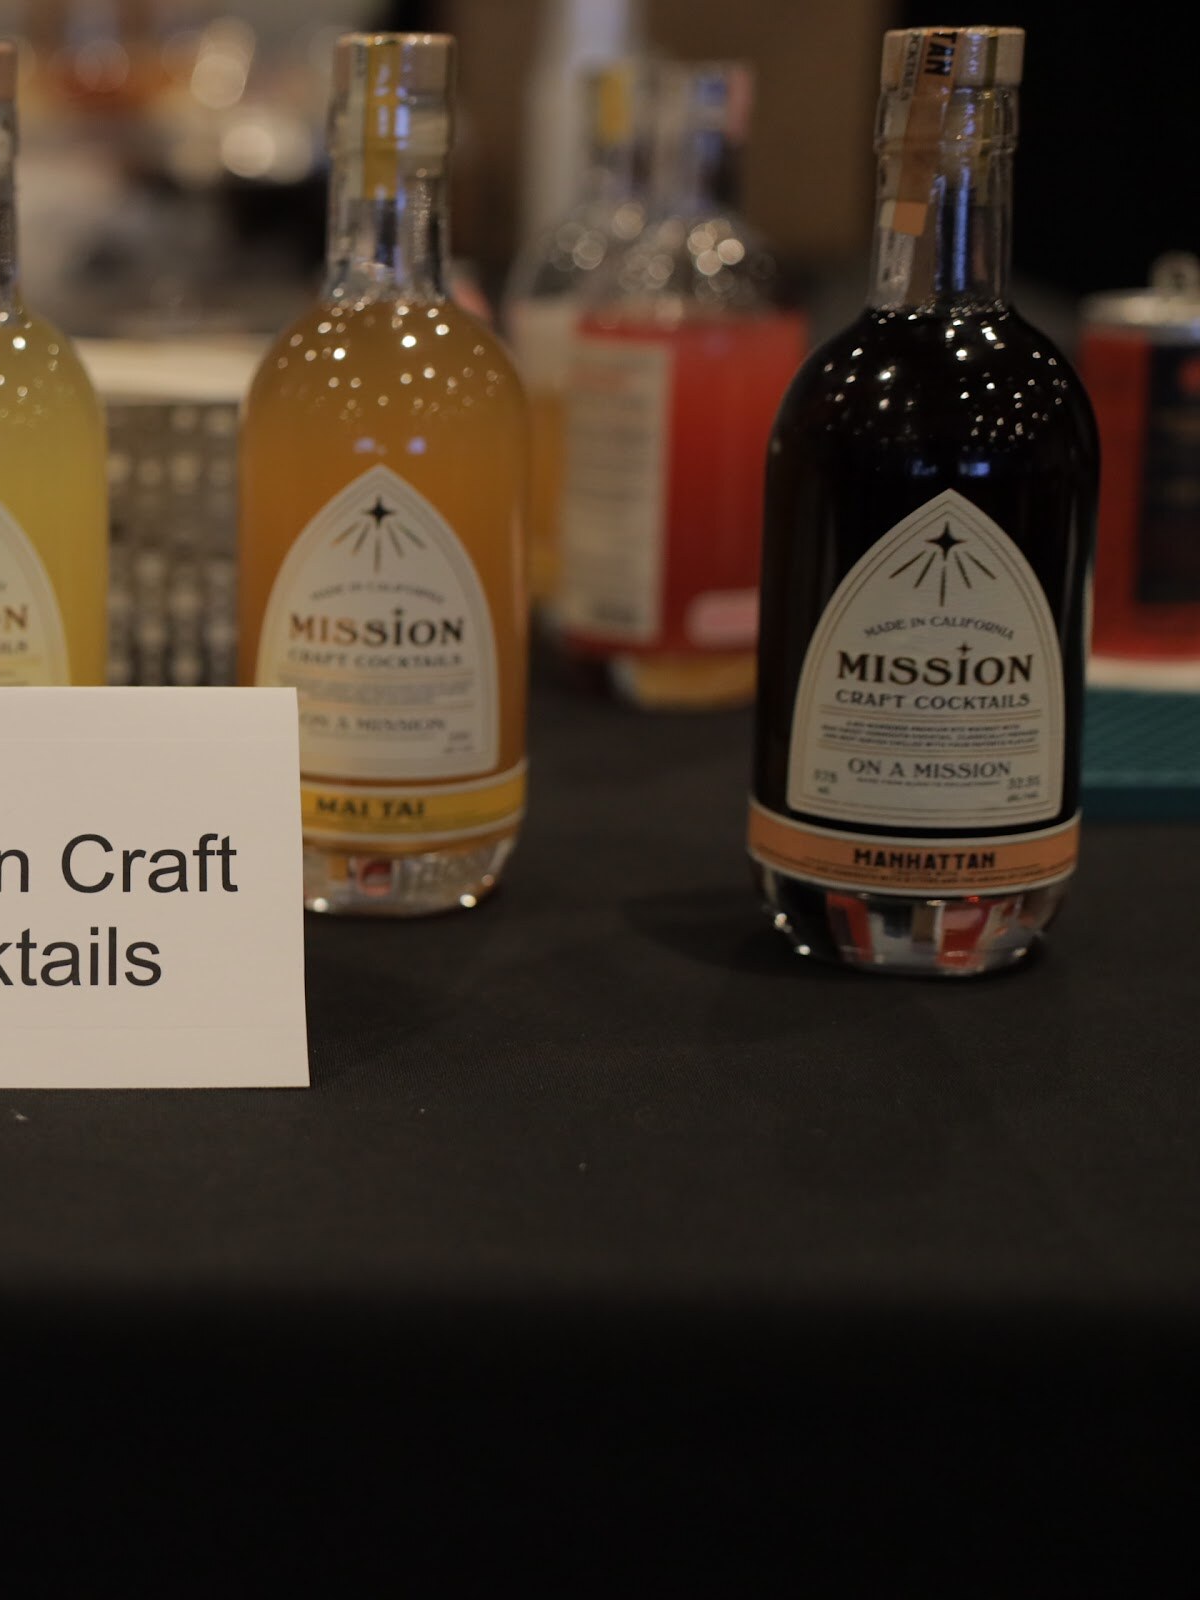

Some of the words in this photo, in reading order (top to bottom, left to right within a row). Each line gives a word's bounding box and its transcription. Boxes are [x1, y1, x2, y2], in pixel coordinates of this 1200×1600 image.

[290, 606, 464, 647] MISSION
[864, 618, 905, 638] MADE
[911, 617, 926, 628] IN
[930, 616, 1014, 640] CALIFORNIA
[837, 642, 1034, 686] MISSION
[836, 689, 906, 708] CRAFT
[914, 693, 1031, 709] COCKTAILS
[848, 758, 881, 775] ON
[889, 762, 904, 778] A
[913, 761, 1011, 778] MISSION
[317, 798, 369, 817] MAI
[382, 800, 426, 817] TAI
[61, 833, 239, 894] Craft
[854, 848, 996, 870] MANHATTAN
